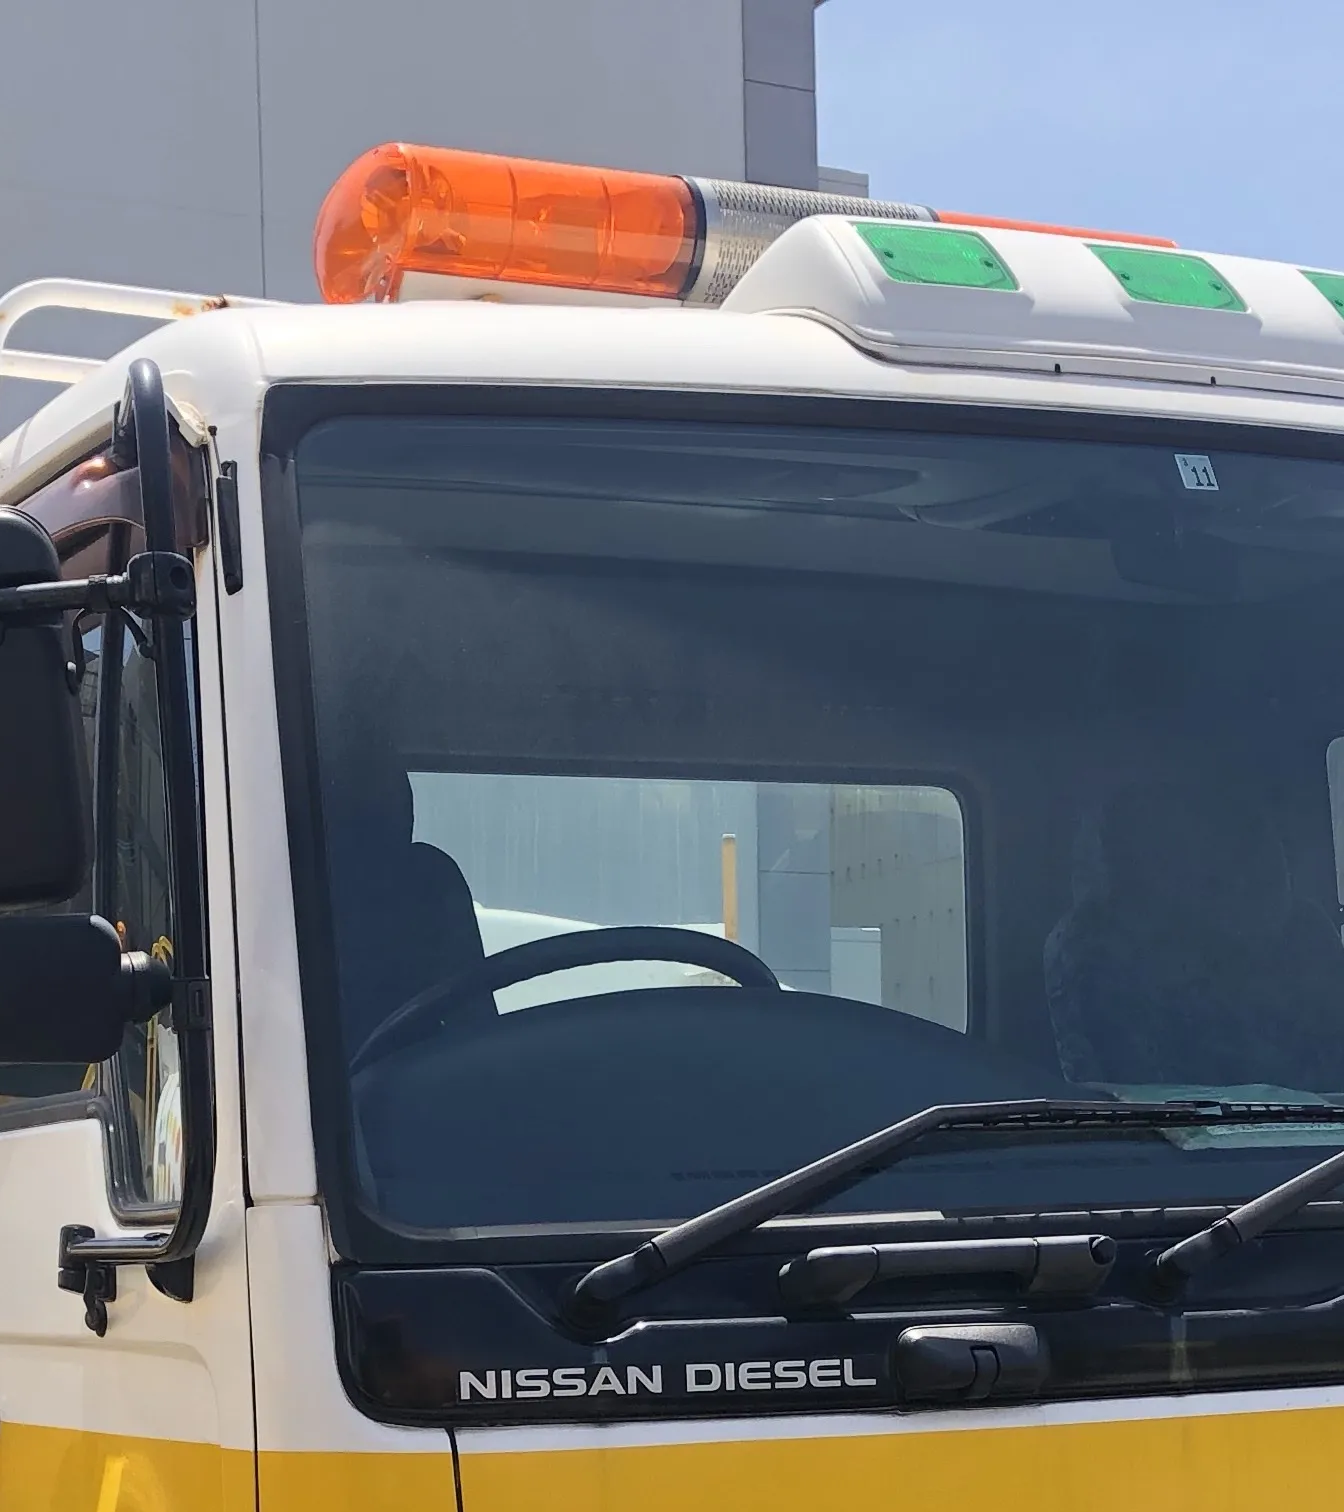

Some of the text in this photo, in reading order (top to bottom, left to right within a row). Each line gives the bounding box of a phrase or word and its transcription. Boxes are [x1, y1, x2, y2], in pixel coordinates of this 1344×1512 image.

[1191, 466, 1215, 487] 11
[459, 1358, 877, 1400] NISSAN DIESEL
